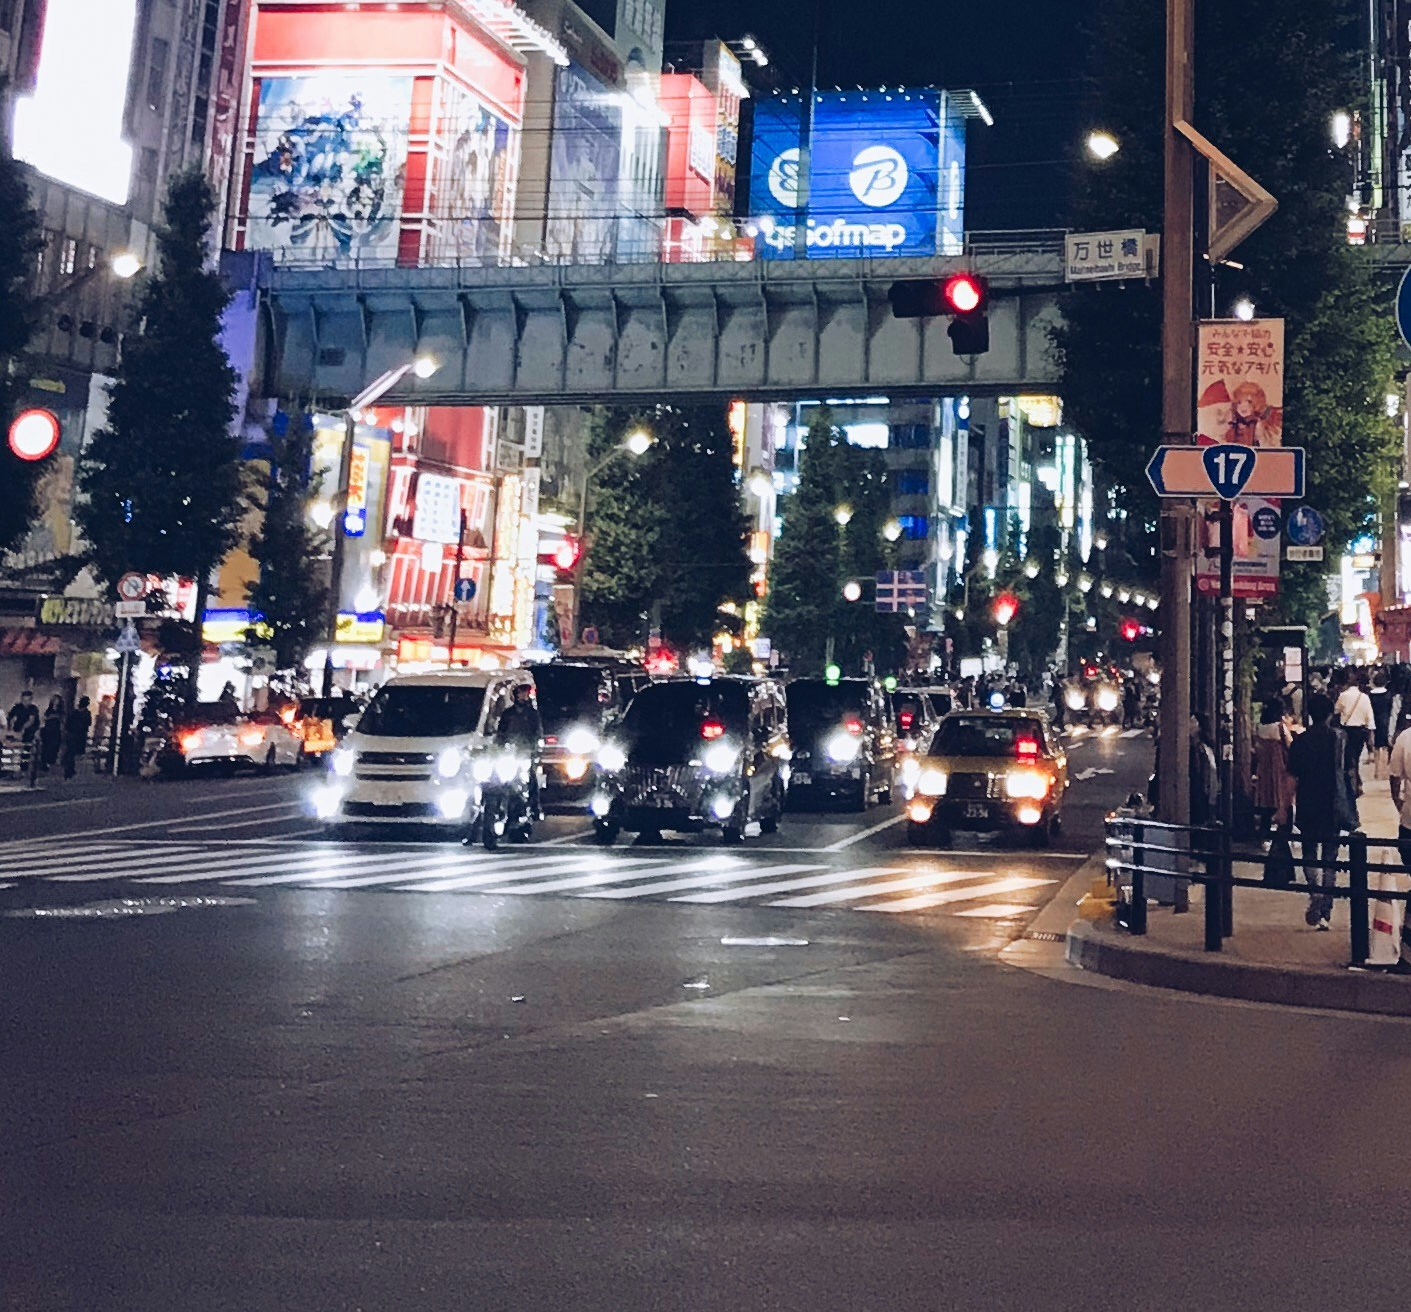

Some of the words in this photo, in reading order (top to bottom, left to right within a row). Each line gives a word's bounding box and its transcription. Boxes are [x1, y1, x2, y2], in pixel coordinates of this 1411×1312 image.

[1073, 238, 1139, 260] 万世橋
[1213, 452, 1247, 485] 17
